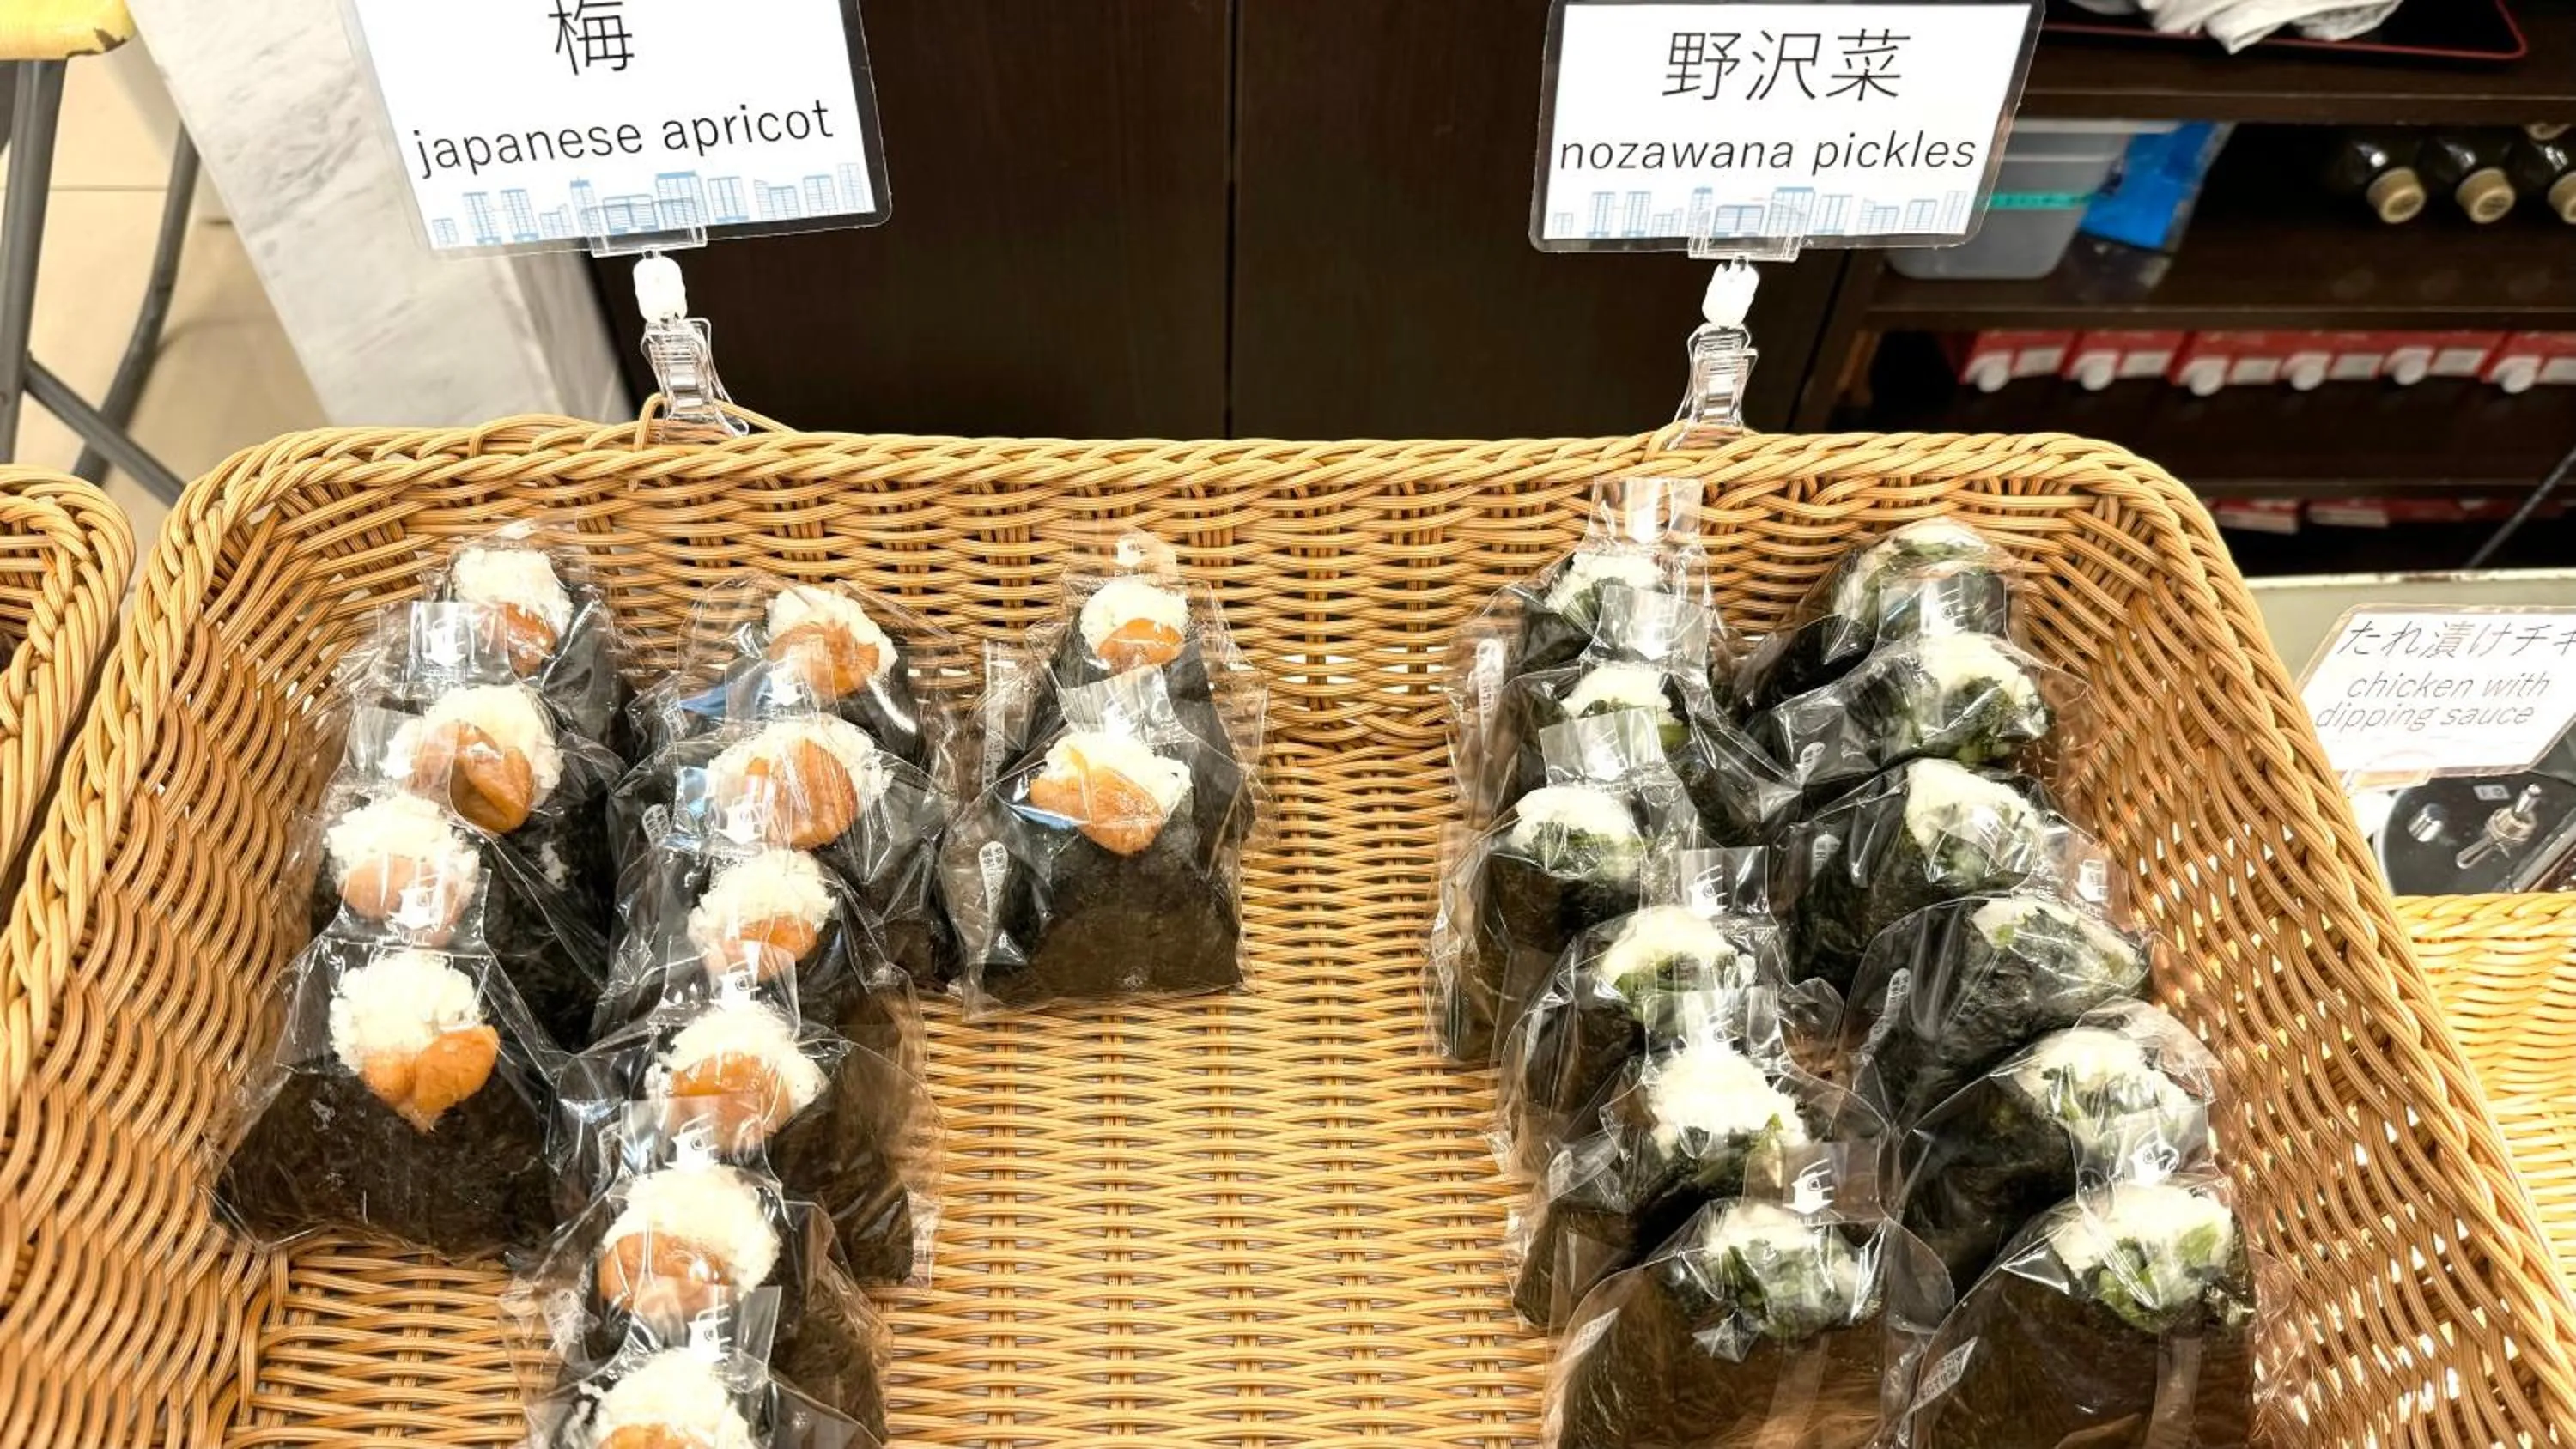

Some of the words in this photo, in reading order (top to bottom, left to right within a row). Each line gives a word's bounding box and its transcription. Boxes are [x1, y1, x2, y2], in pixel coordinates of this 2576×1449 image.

[548, 0, 635, 76] 梅
[1662, 28, 1911, 101] 野沢菜
[413, 124, 643, 179] japanese
[662, 100, 834, 157] apricot
[1560, 142, 1794, 169] nozawana
[1812, 130, 1976, 176] pickles
[2347, 670, 2474, 698] chicken
[2482, 671, 2550, 698] with
[2314, 701, 2441, 731] dipping
[2439, 706, 2535, 725] sauce
